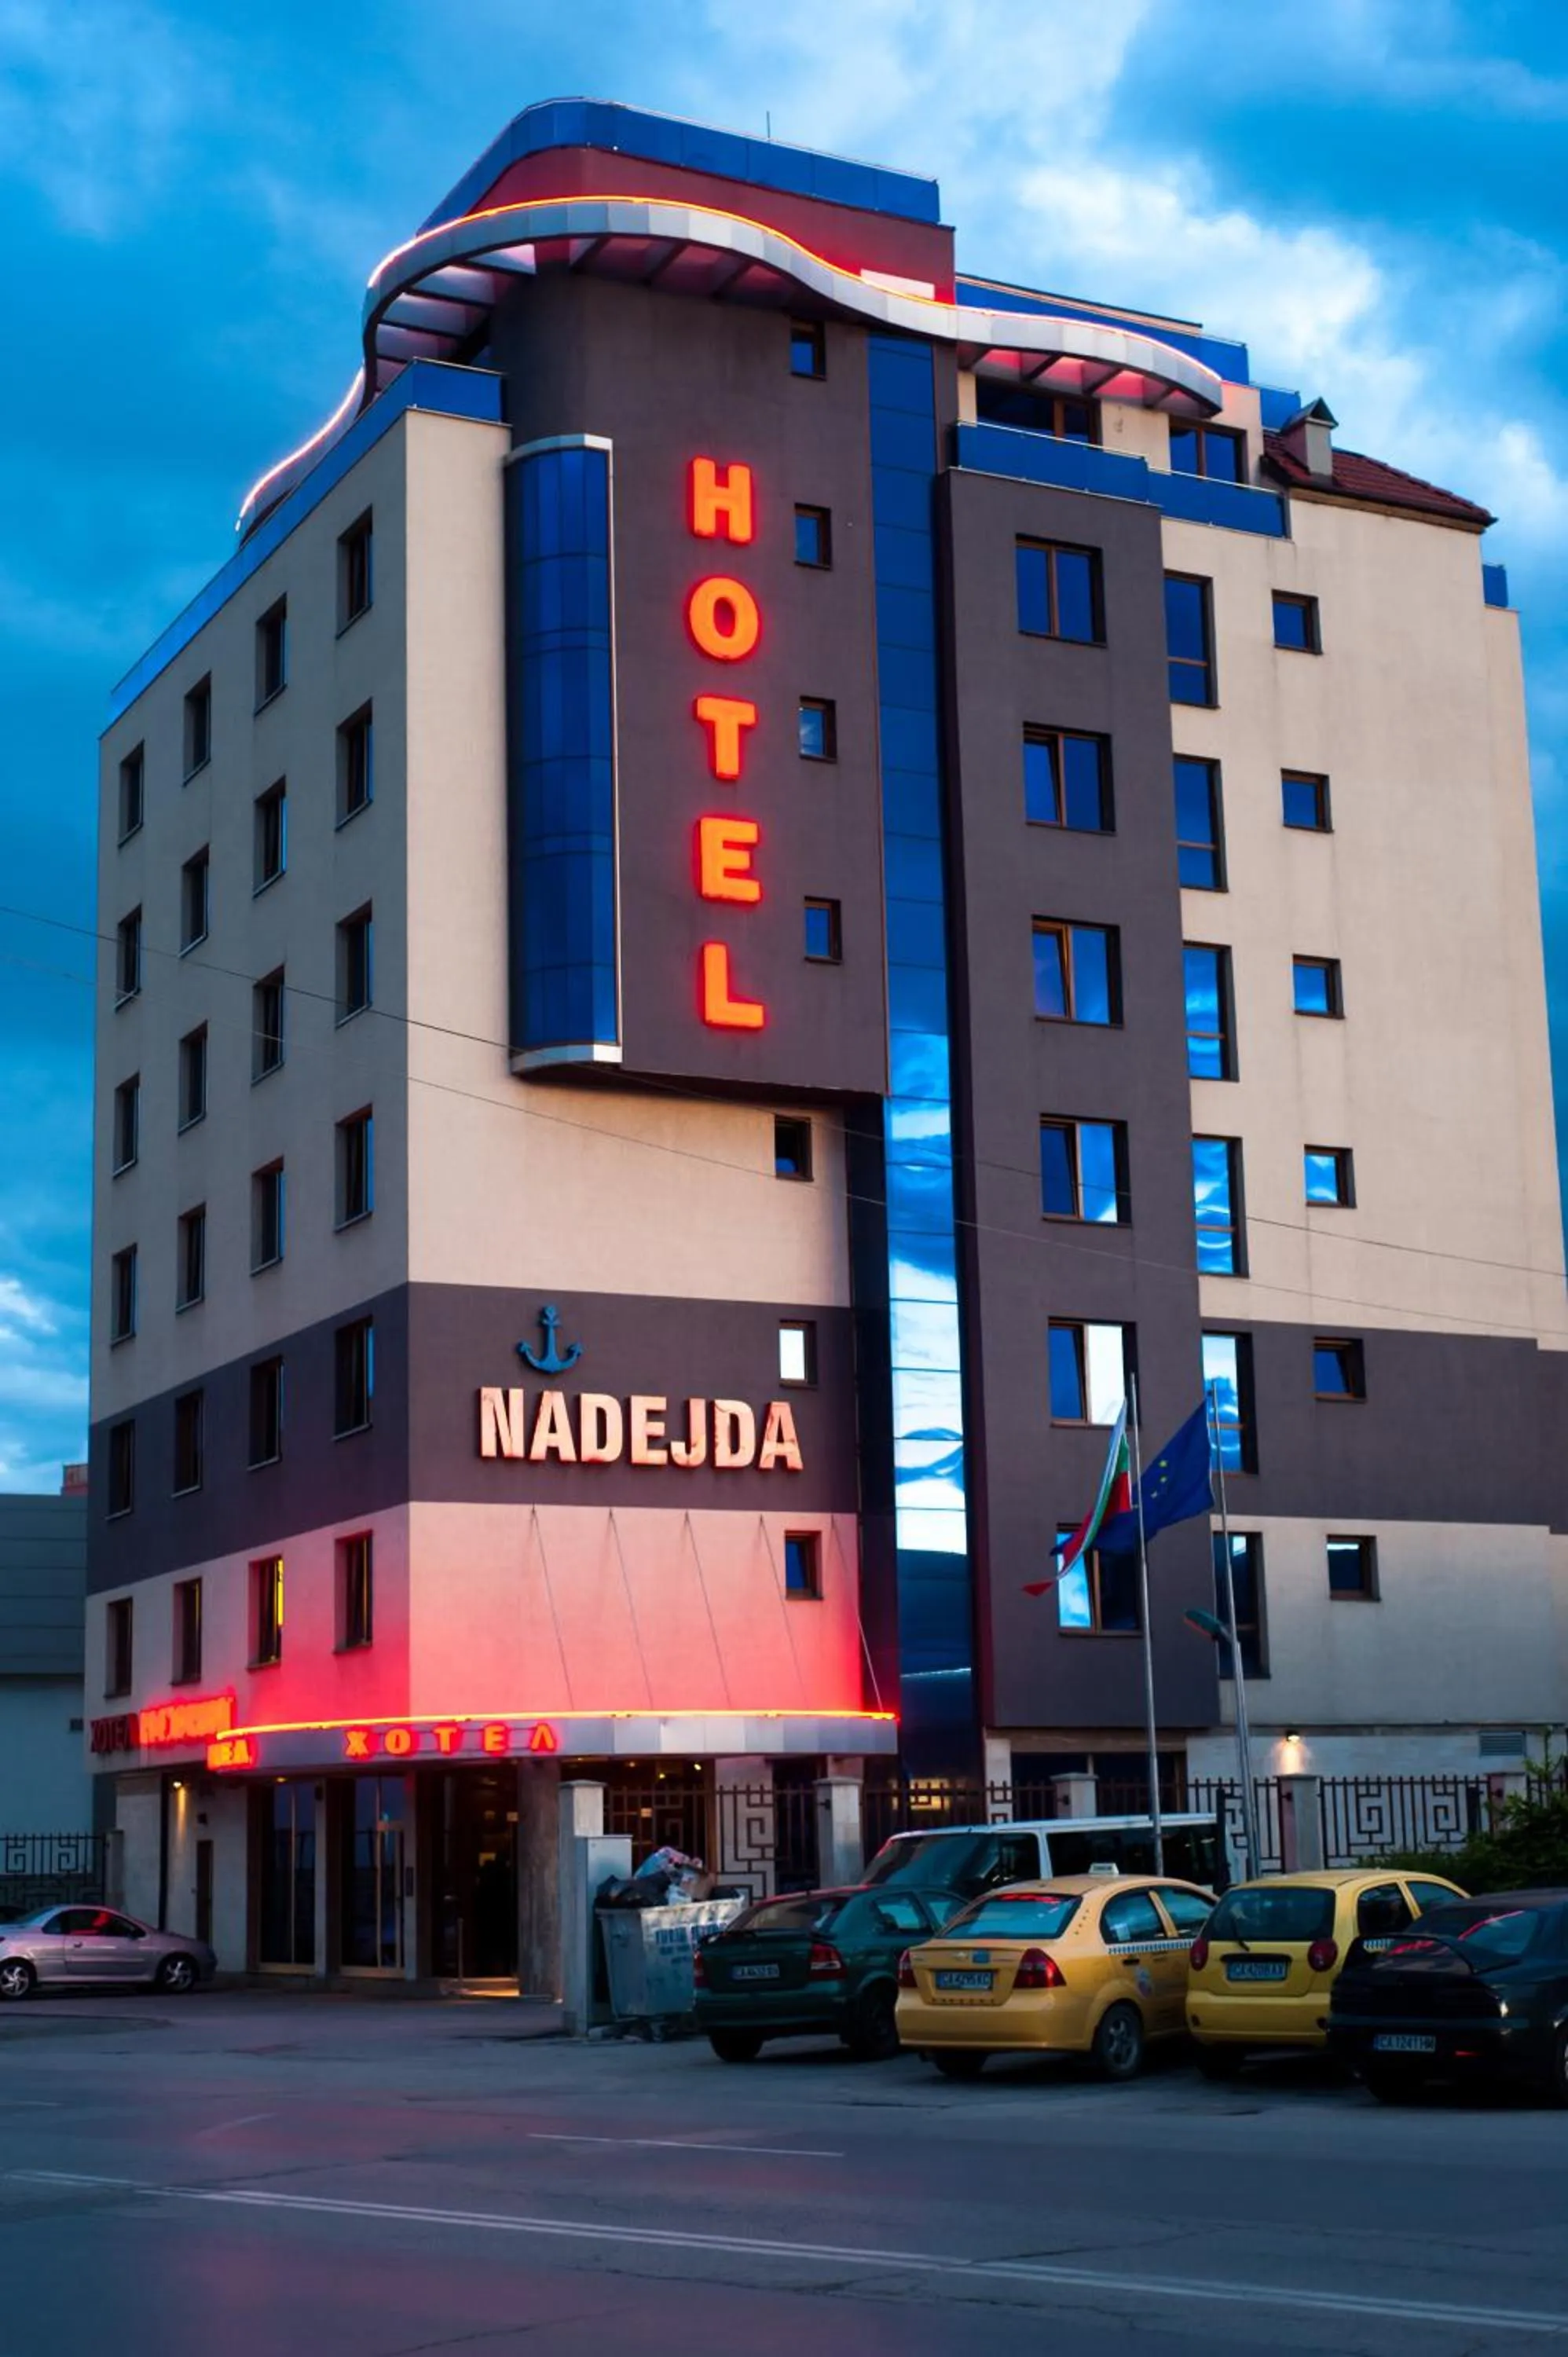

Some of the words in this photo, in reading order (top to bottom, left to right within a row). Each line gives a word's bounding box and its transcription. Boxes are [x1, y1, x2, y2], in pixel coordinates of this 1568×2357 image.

[689, 456, 765, 1029] HOTEL
[477, 1385, 804, 1471] NADEJDA
[345, 1724, 556, 1758] ХОТЕЛ
